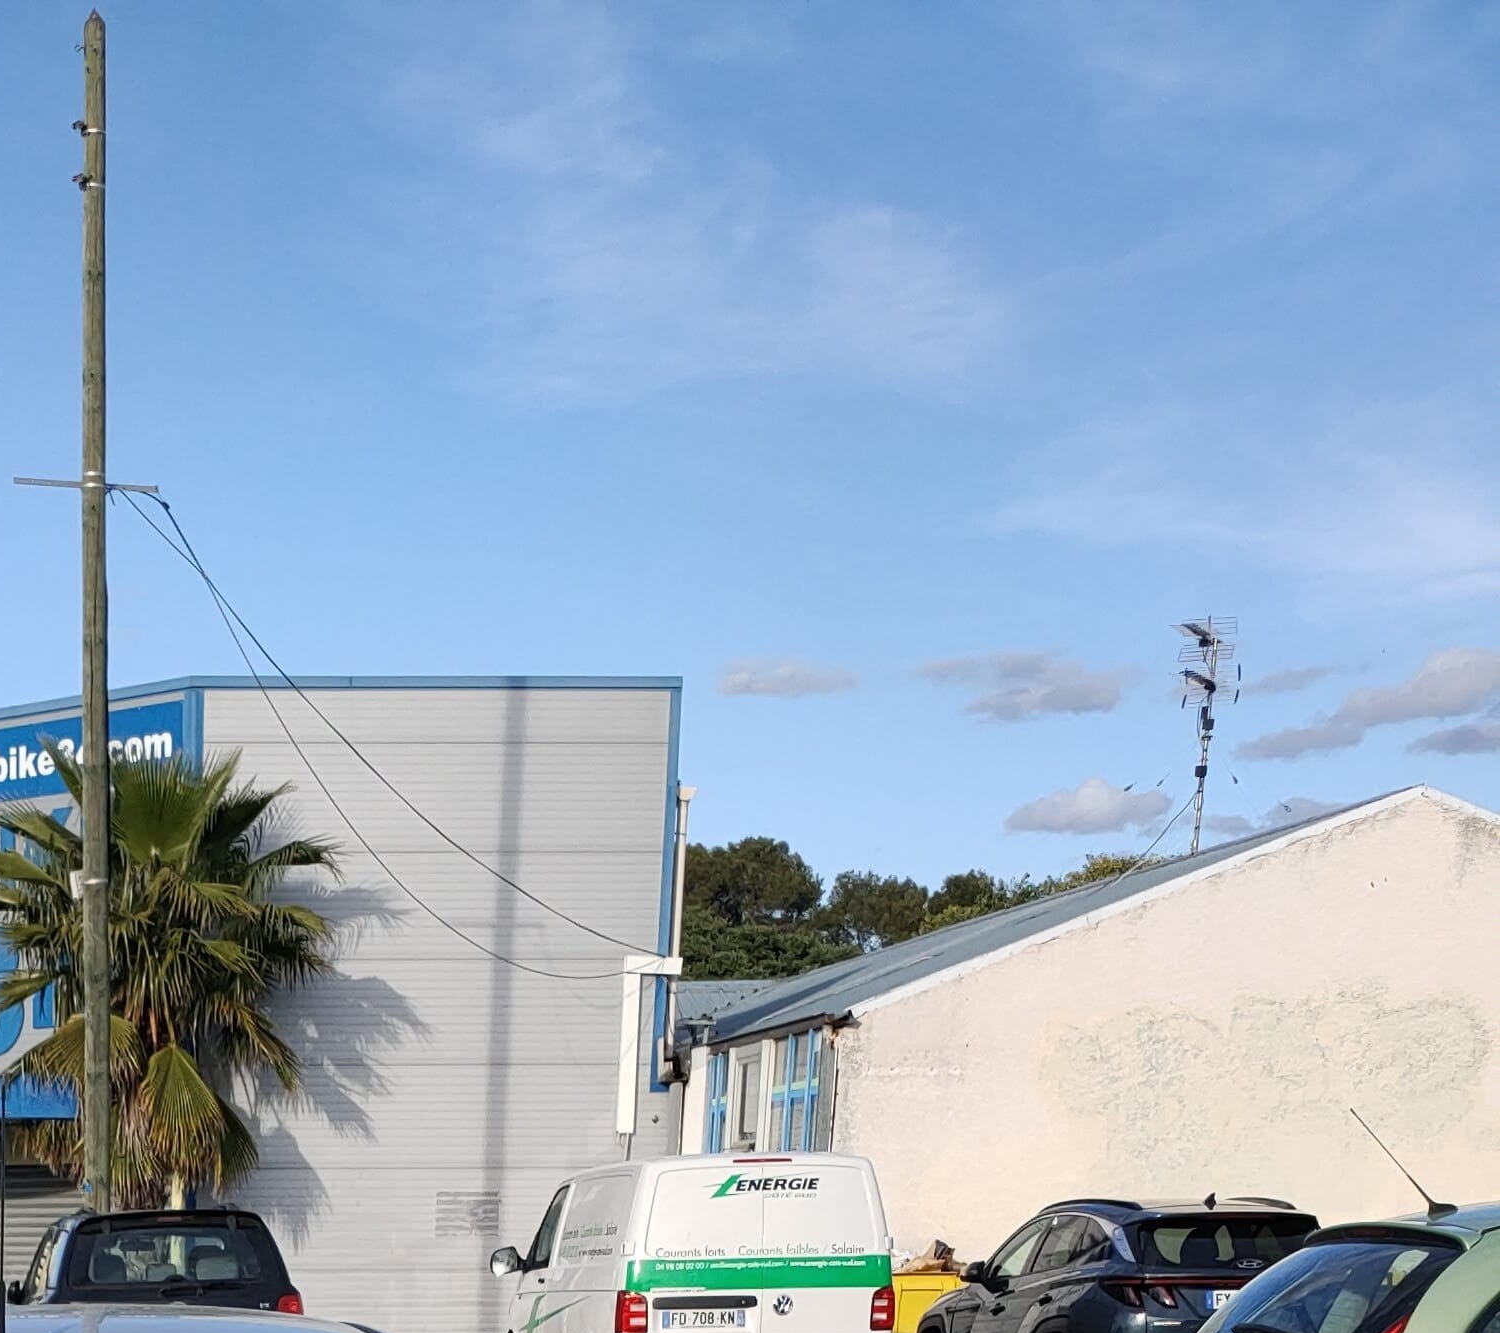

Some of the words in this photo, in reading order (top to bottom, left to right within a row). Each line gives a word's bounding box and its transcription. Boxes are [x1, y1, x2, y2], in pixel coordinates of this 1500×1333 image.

[736, 1177, 820, 1191] ENERGIE
[655, 1247, 702, 1258] Courants
[705, 1244, 726, 1257] forts
[738, 1245, 783, 1256] Courants
[786, 1243, 820, 1255] faibles
[831, 1241, 865, 1254] Solaire
